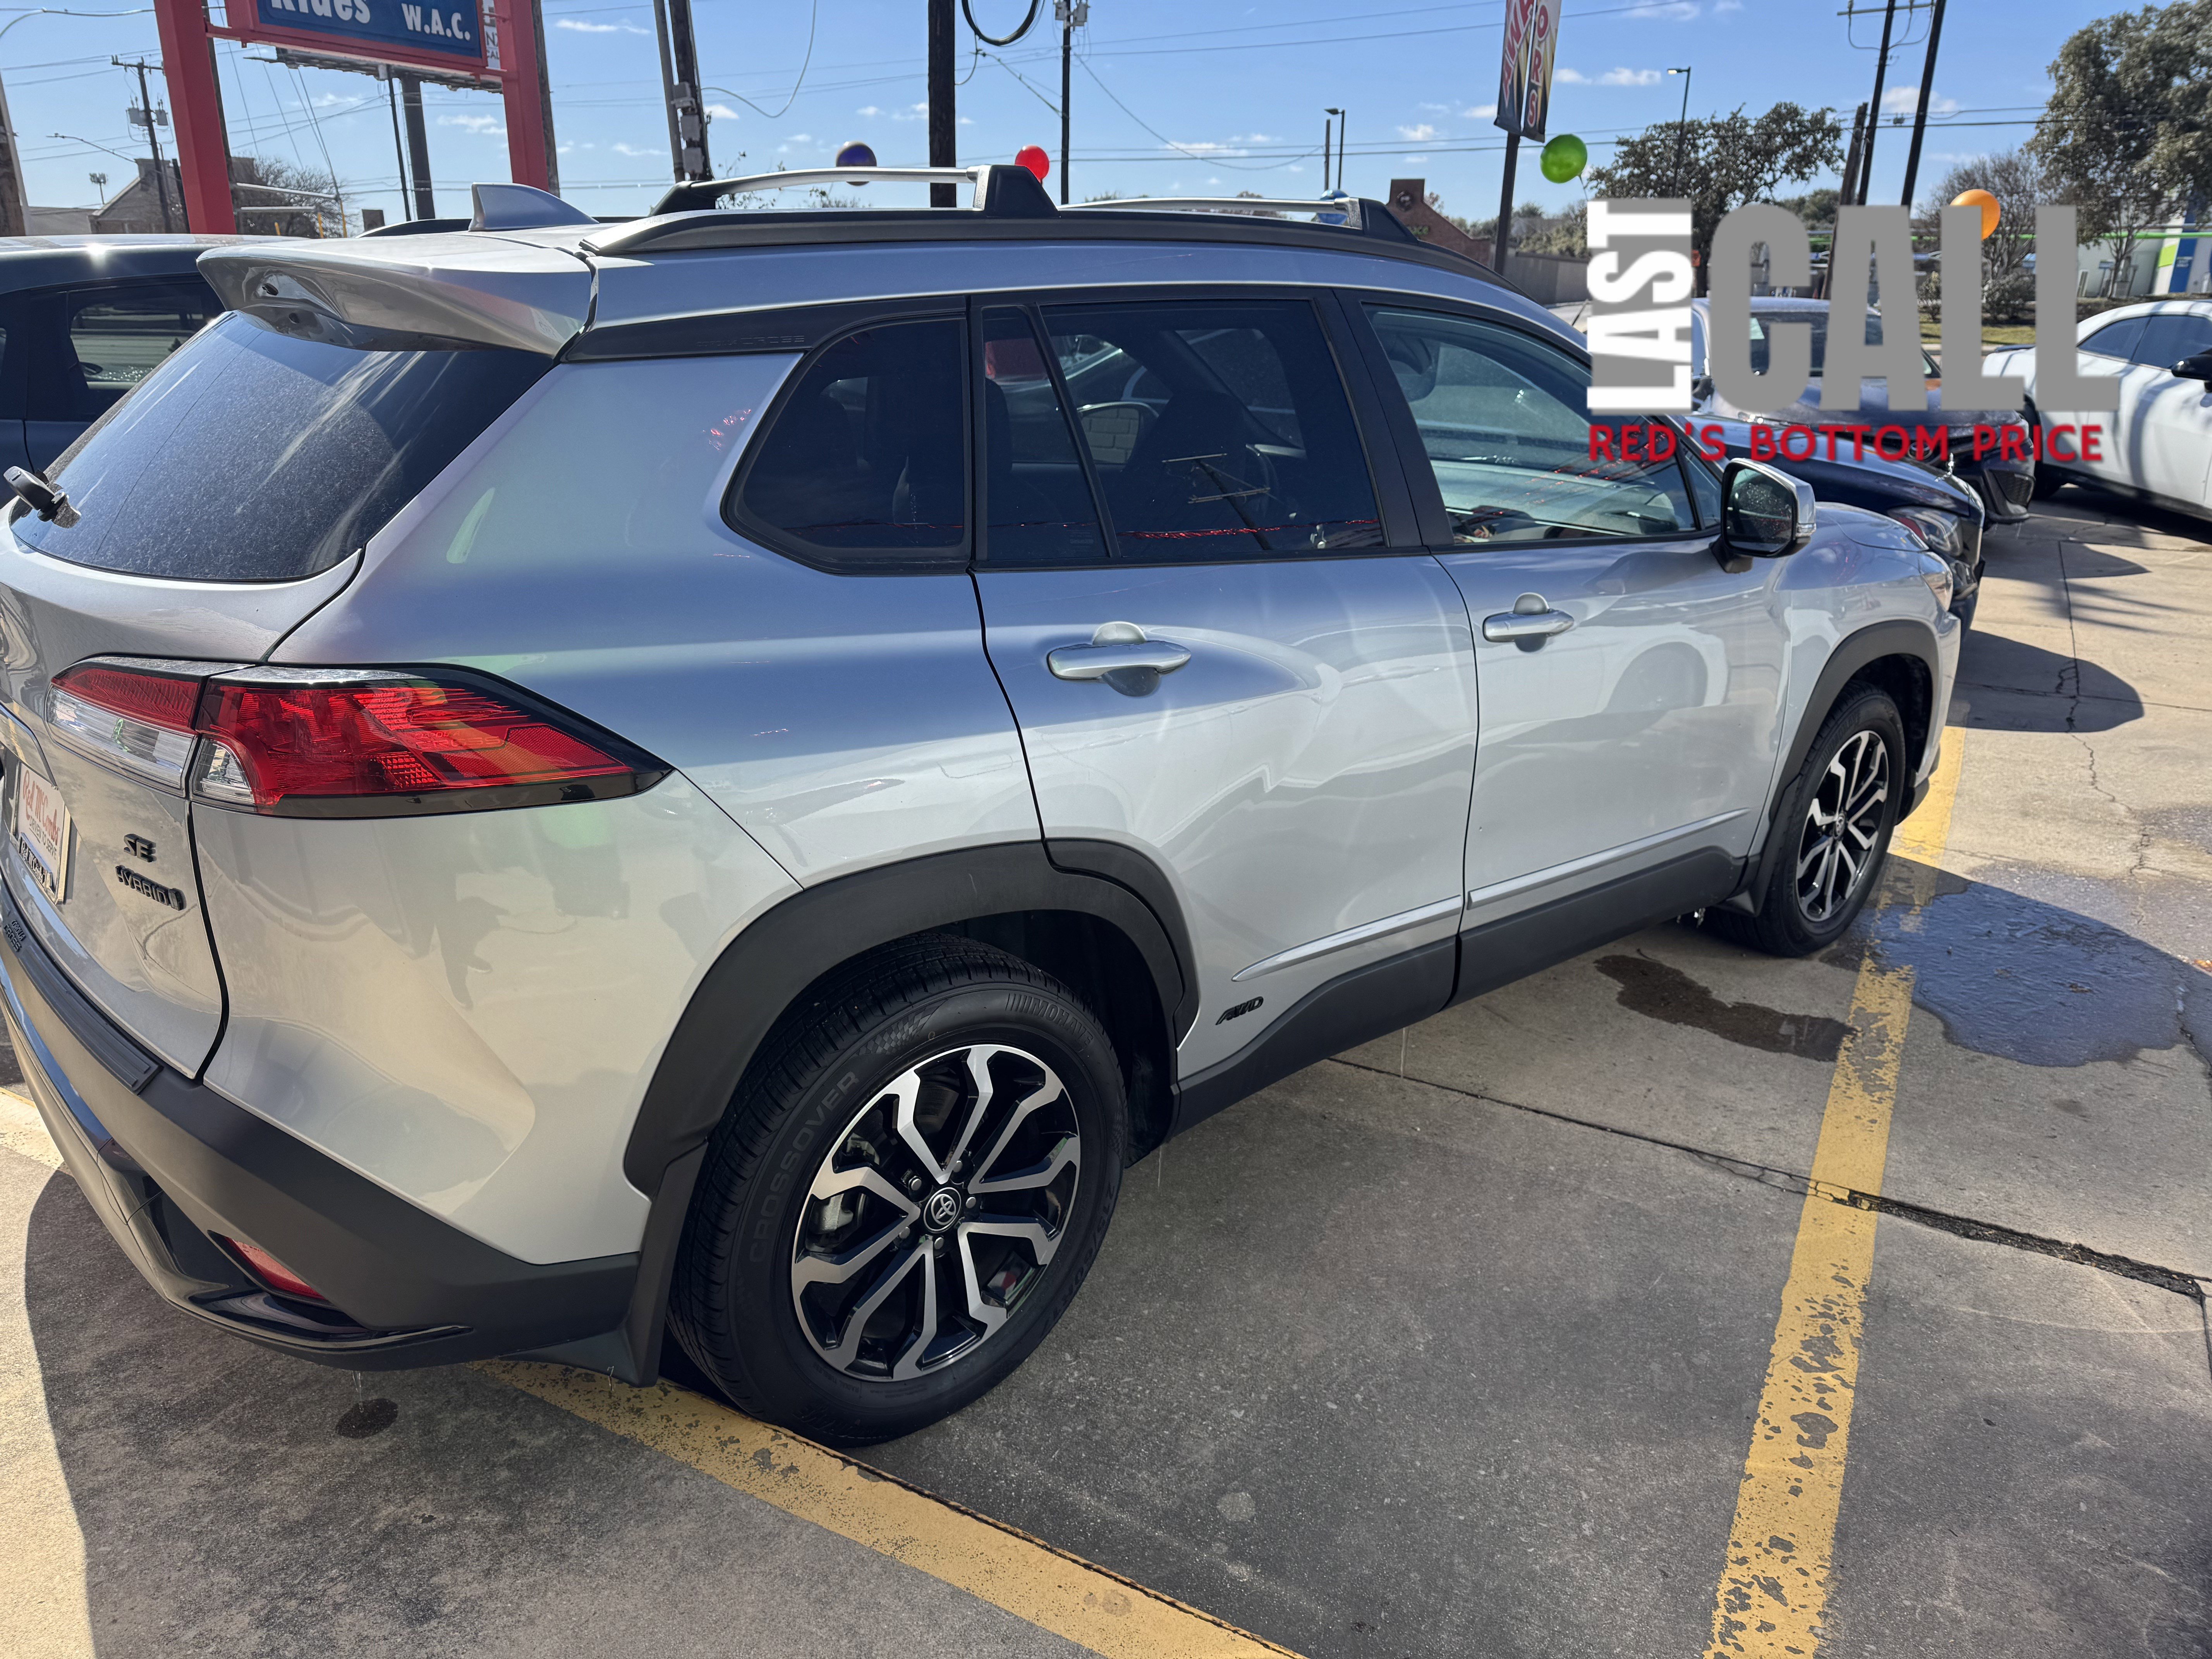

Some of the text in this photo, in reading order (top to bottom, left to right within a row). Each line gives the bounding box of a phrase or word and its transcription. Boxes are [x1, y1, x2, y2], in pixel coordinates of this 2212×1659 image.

[401, 3, 471, 41] W.A.C.
[23, 769, 35, 821] Red
[41, 830, 46, 845] TO
[124, 834, 155, 863] SE
[115, 865, 172, 906] HYBRID
[1032, 996, 1094, 1052] MOHAVE
[1215, 996, 1264, 1025] AWD
[749, 1071, 860, 1263] CROSSOVER
